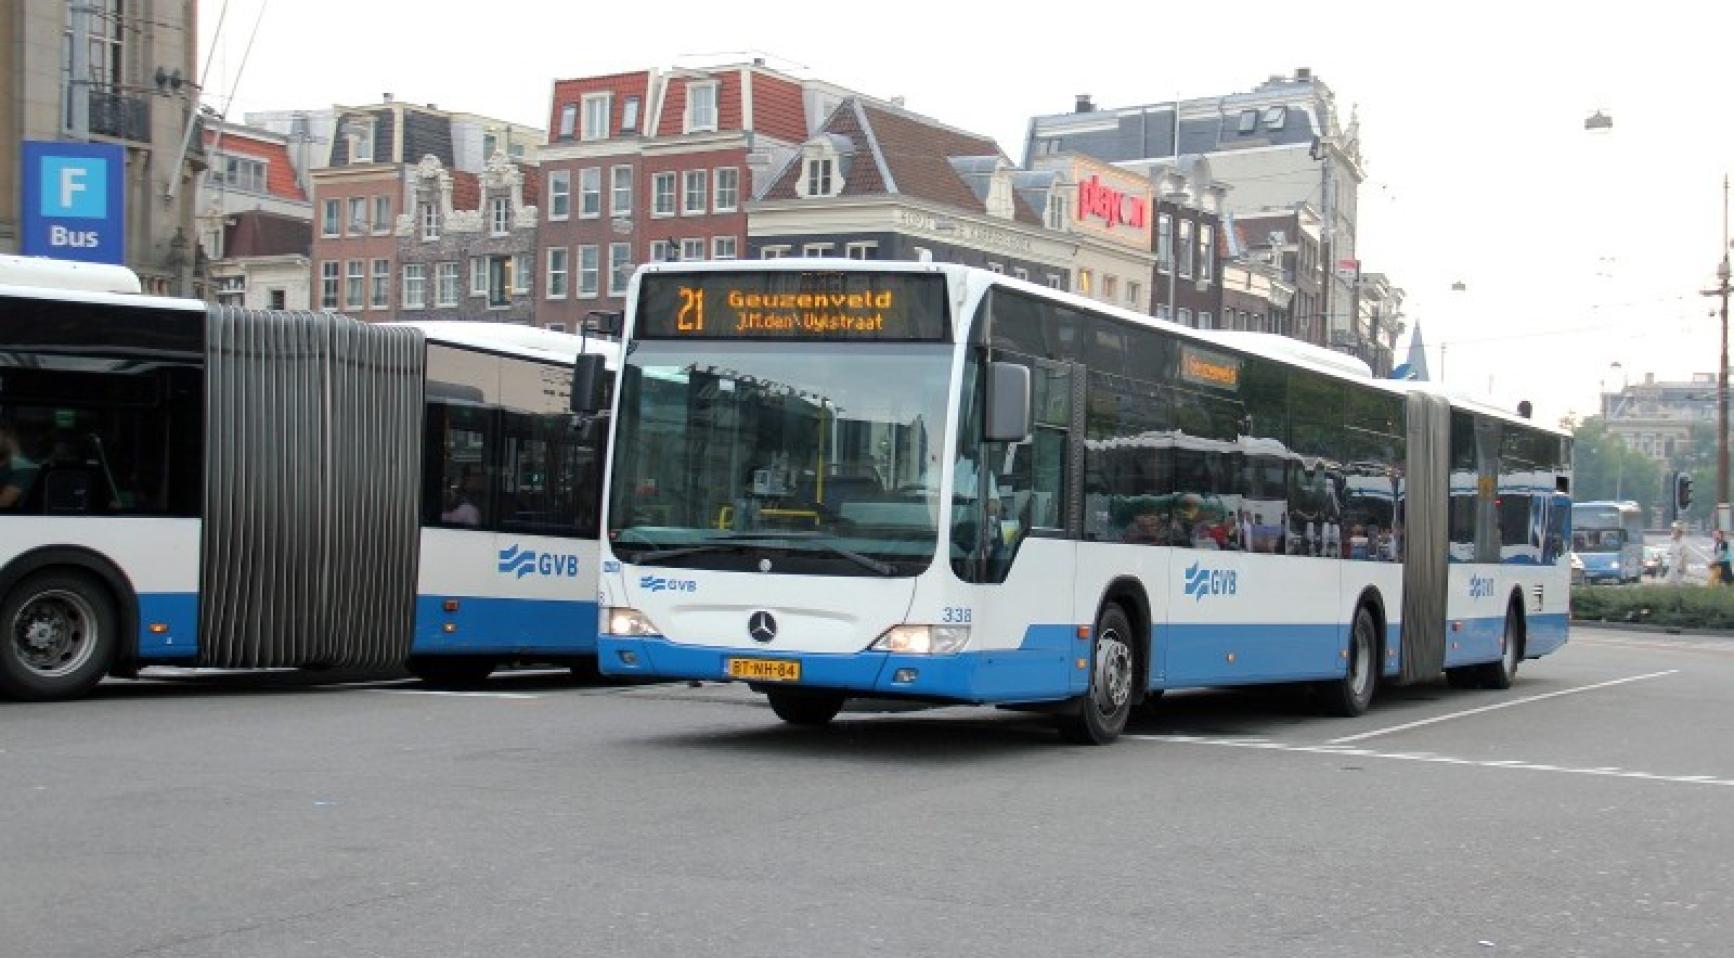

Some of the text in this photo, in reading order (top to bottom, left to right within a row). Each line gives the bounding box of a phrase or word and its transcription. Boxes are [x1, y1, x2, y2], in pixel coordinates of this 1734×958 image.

[61, 167, 87, 208] F
[50, 225, 99, 248] Bus
[677, 285, 704, 331] 21
[727, 289, 892, 309] Geuzenveld
[803, 312, 884, 332] Uylstraat
[539, 553, 579, 577] GVB
[667, 579, 697, 593] GVB
[1211, 569, 1236, 595] GVB
[942, 606, 972, 623] 338
[731, 660, 797, 678] BT-NH-84
